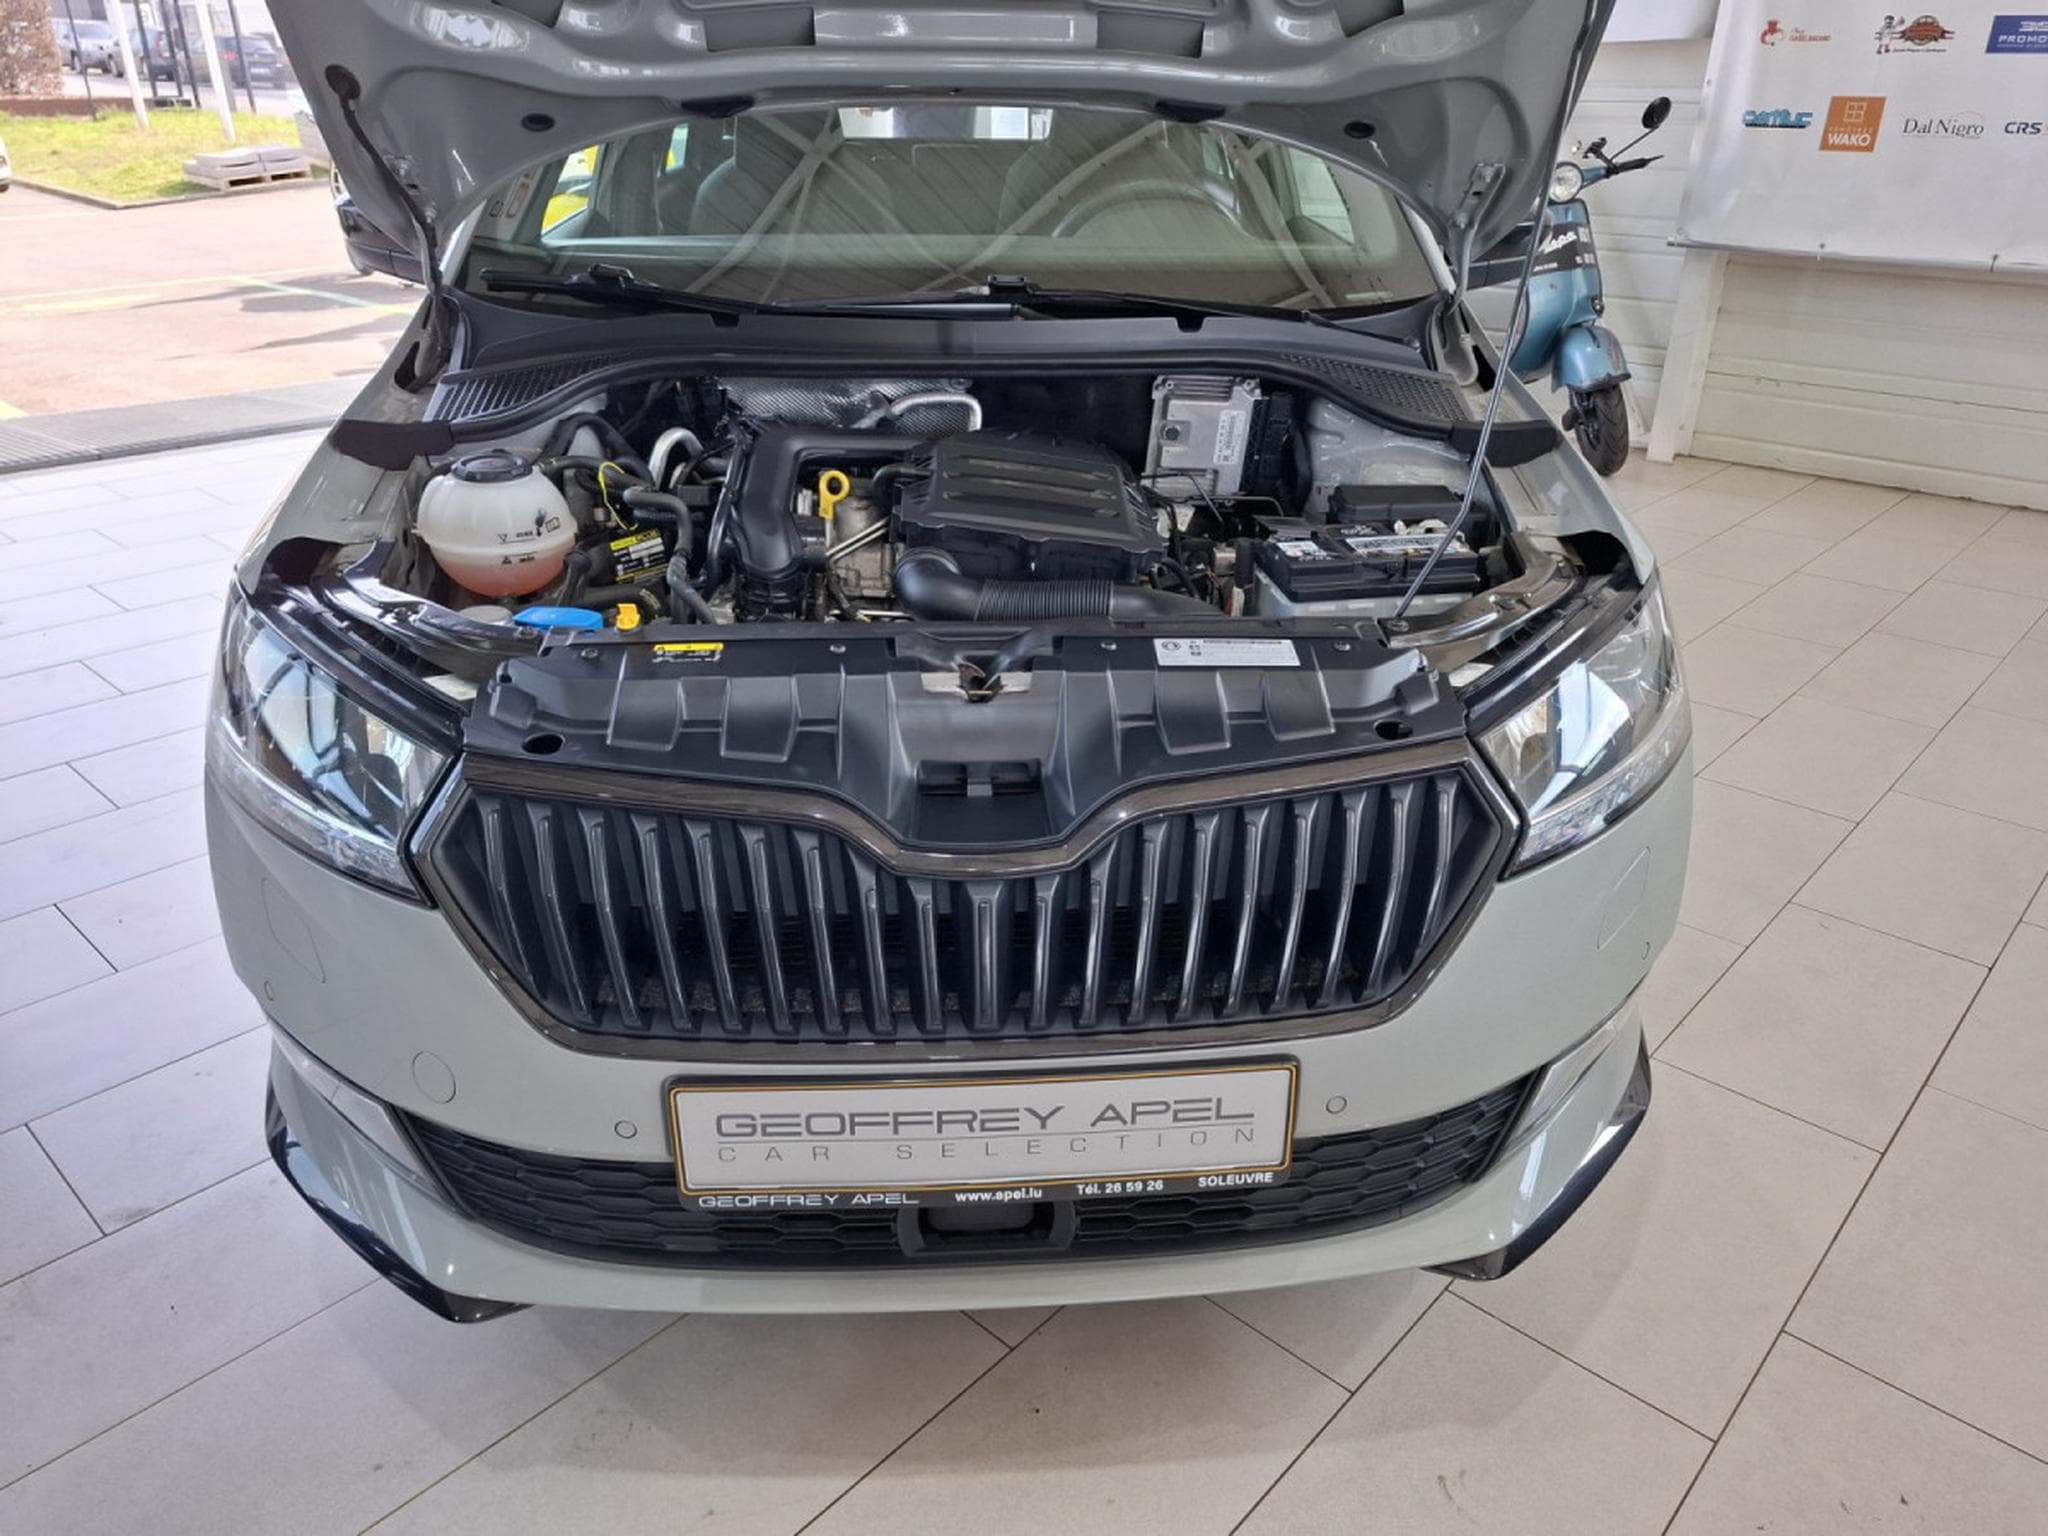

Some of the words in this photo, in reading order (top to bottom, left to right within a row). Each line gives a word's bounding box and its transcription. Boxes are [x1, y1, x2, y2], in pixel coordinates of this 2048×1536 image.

[1828, 132, 1871, 146] WAKO
[1903, 117, 1933, 134] Dal
[1936, 117, 1984, 138] Nigro
[2004, 121, 2043, 135] CRS
[715, 1105, 1066, 1138] GEOFFREY
[1090, 1097, 1255, 1127] APEL
[717, 1144, 830, 1163] CAR
[896, 1127, 1255, 1160] SELECTION
[698, 1193, 839, 1208] GEOFFREY
[851, 1192, 920, 1205] APEL
[954, 1187, 1043, 1204] www.apel.lu
[1105, 1182, 1122, 1194] 26
[1126, 1181, 1143, 1193] 59
[1146, 1180, 1164, 1192] 26
[1197, 1171, 1274, 1188] SOLEUVRE
